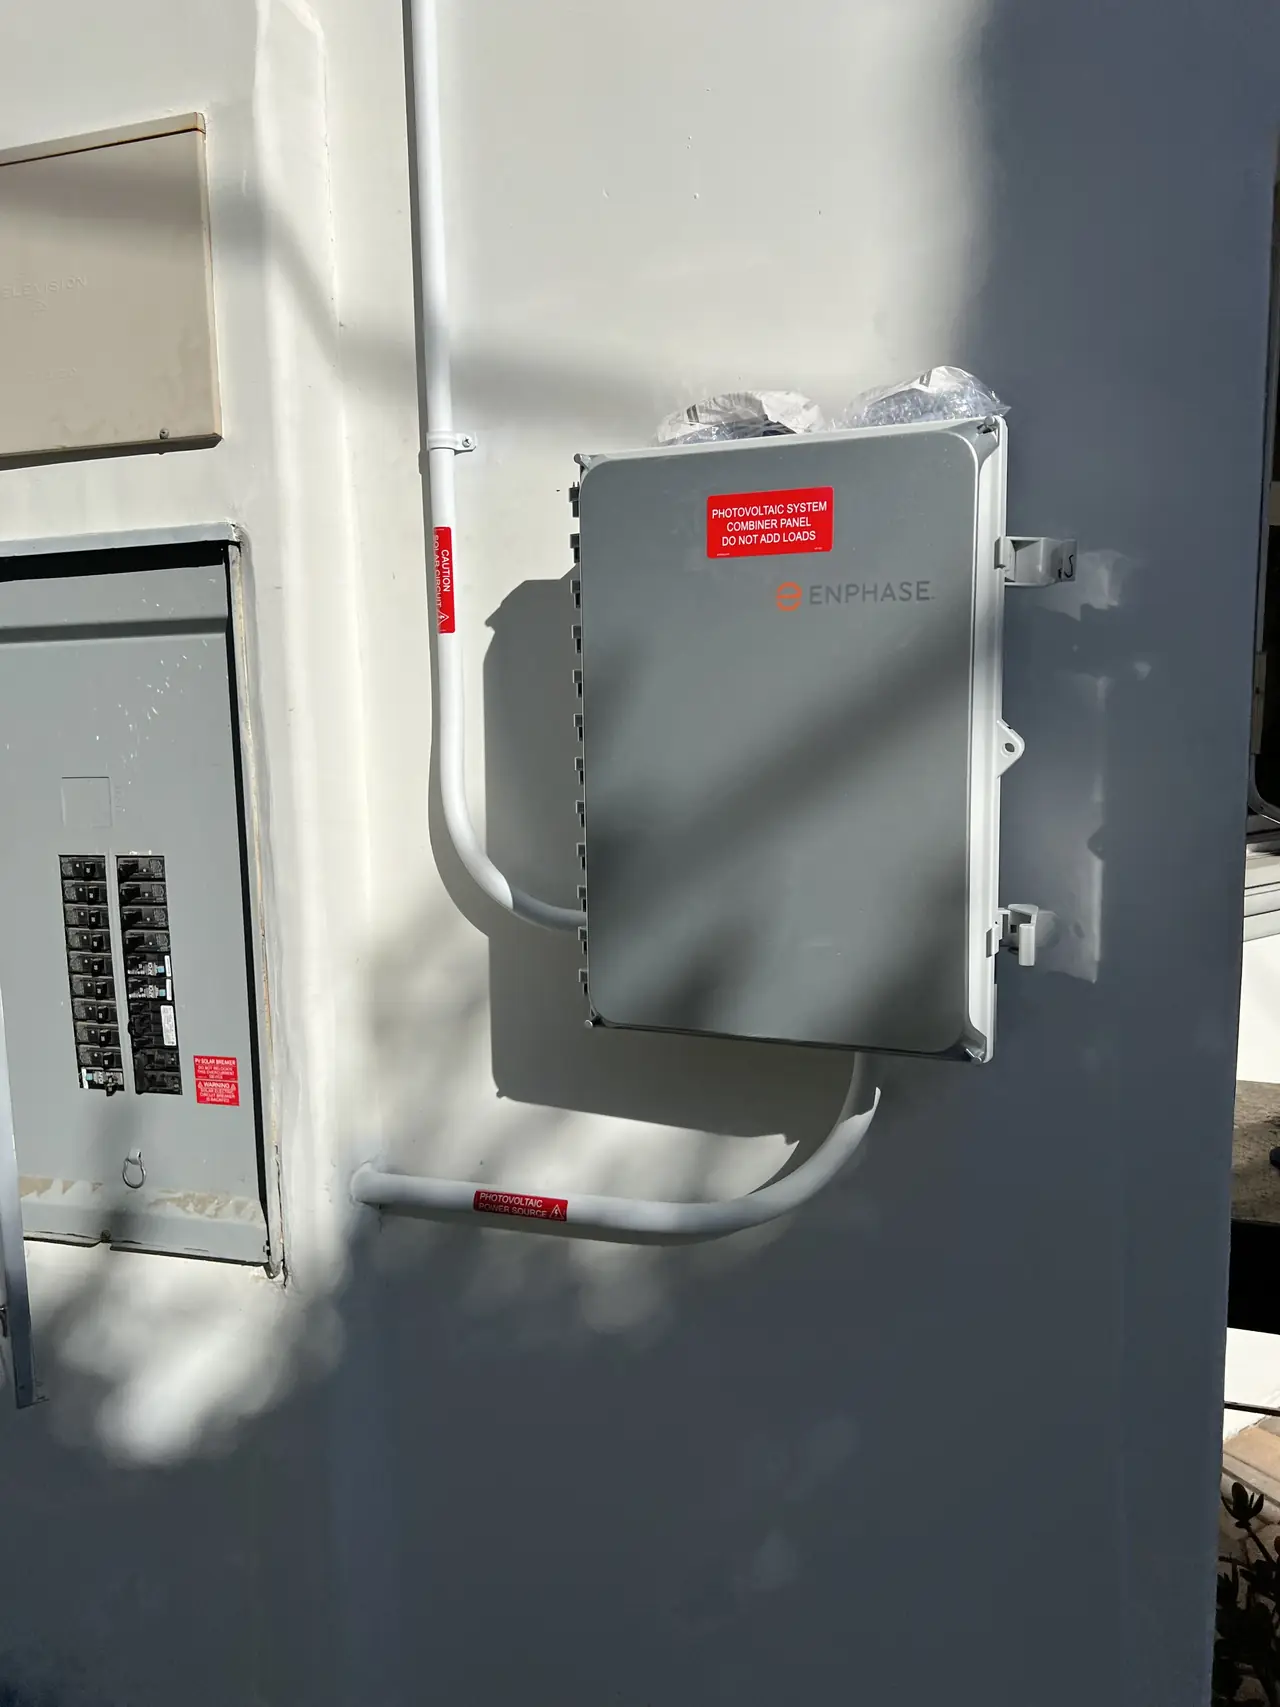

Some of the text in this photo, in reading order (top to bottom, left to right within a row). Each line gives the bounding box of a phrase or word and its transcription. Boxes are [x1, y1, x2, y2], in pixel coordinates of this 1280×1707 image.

[711, 500, 828, 519] PHOTOVOLTAIC SYSTEM
[726, 516, 812, 532] COMBINER PANEL
[721, 530, 816, 547] DO NOT ADD LOADS
[440, 549, 451, 593] CAUTION
[434, 569, 442, 608] CIRCUIT
[808, 580, 932, 606] ENPHASE
[203, 1081, 230, 1089] WARNING
[479, 1192, 544, 1208] PHOTOVOLTAIC
[478, 1202, 548, 1218] POWER SOURCE
